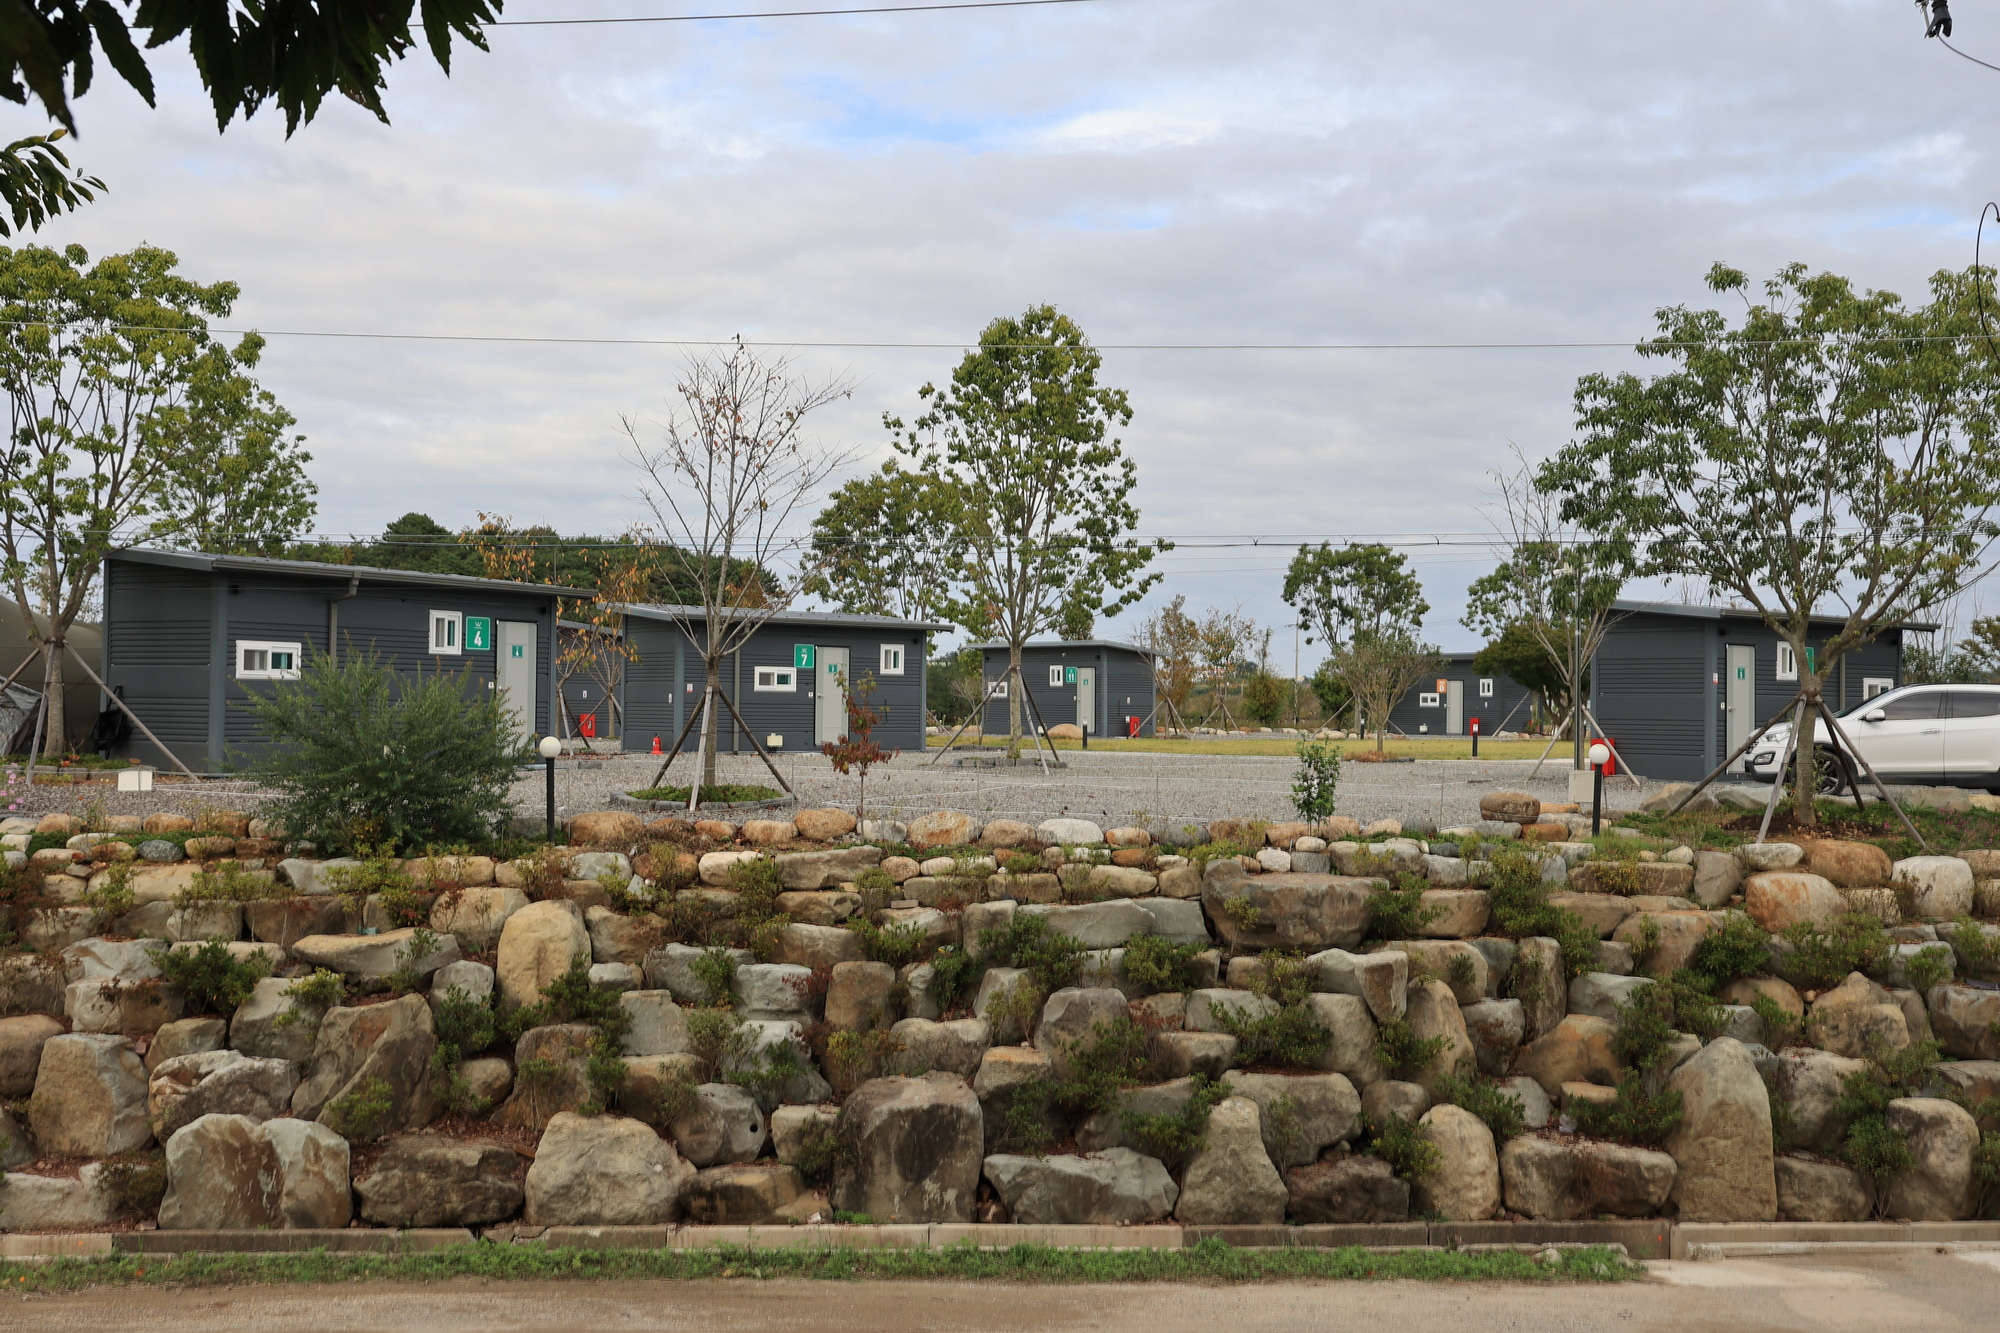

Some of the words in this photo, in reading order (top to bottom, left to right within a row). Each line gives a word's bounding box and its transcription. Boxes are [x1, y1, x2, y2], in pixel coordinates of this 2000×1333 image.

[474, 630, 482, 647] 4
[801, 654, 808, 666] 7
[1068, 673, 1075, 681] 11
